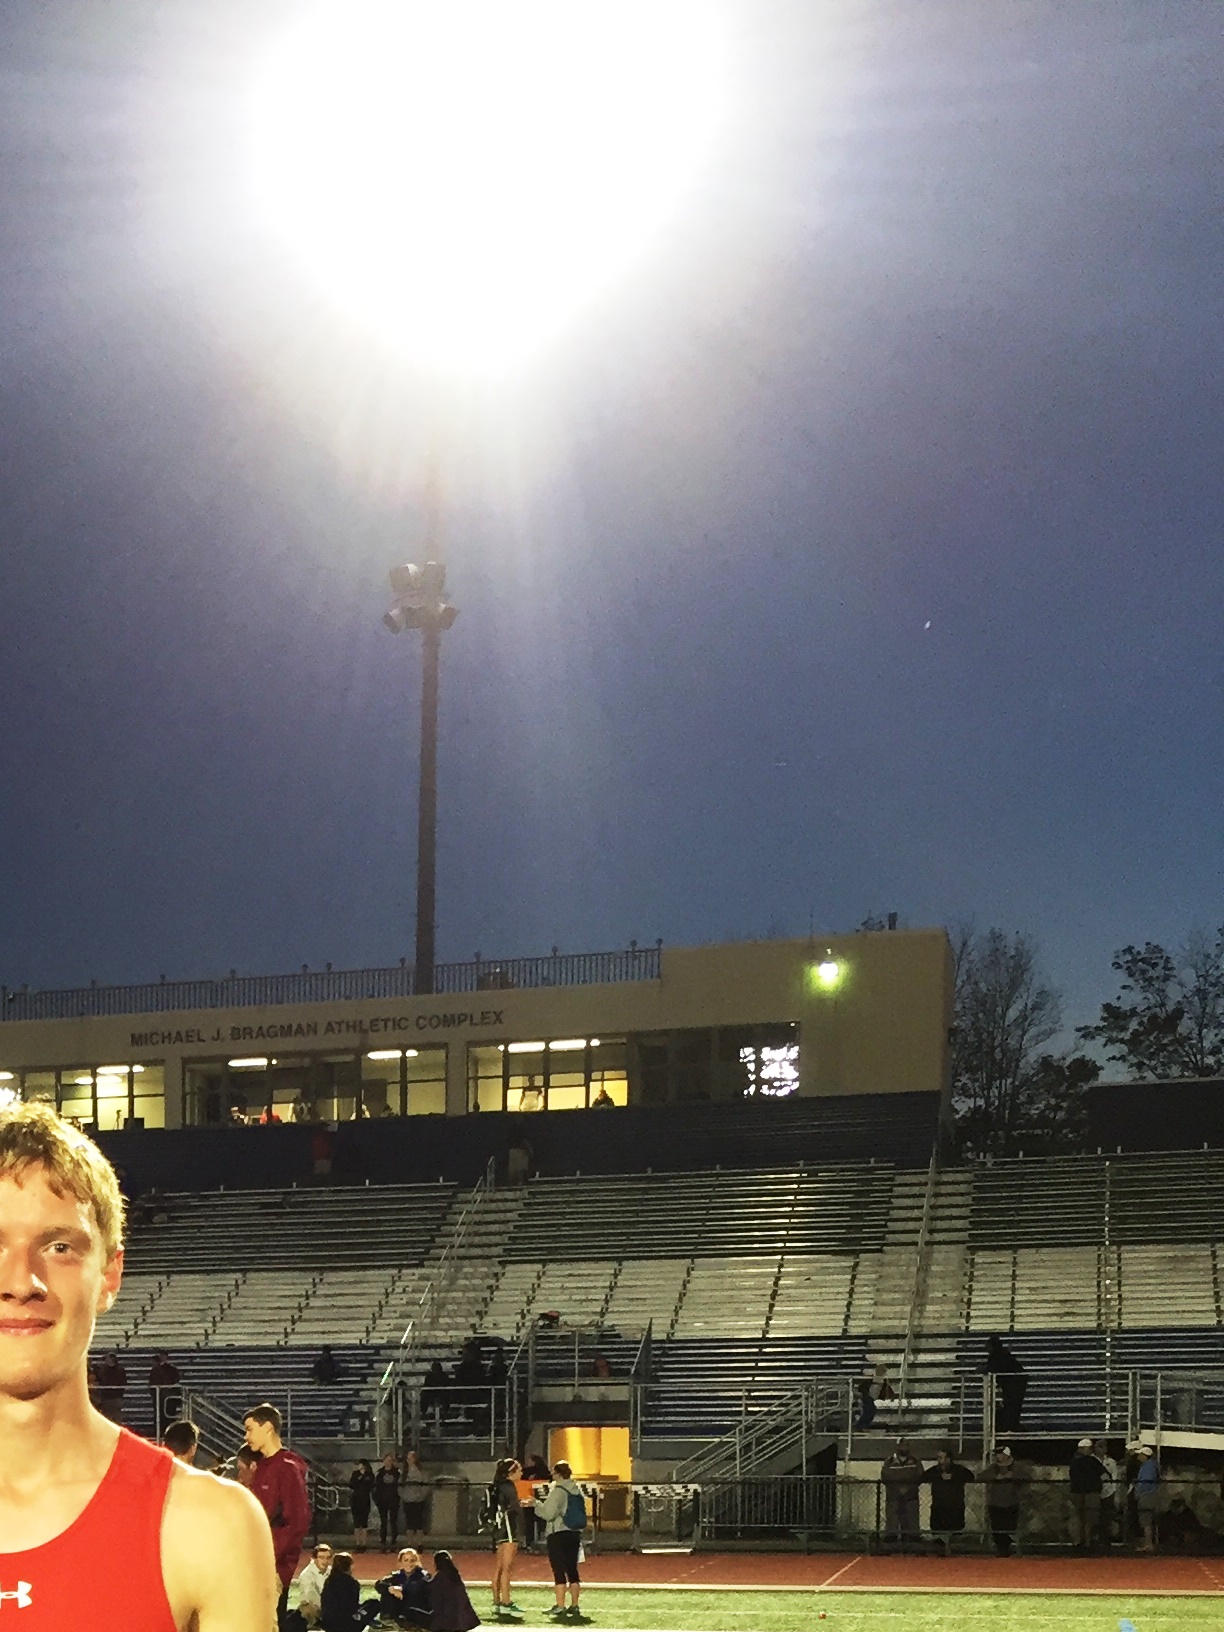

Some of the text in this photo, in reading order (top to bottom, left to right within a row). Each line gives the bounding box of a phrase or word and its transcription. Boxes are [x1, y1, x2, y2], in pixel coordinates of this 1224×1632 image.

[130, 1010, 504, 1047] MICHAEL J. BRAGMAN ATHLETIC COMPLEX
